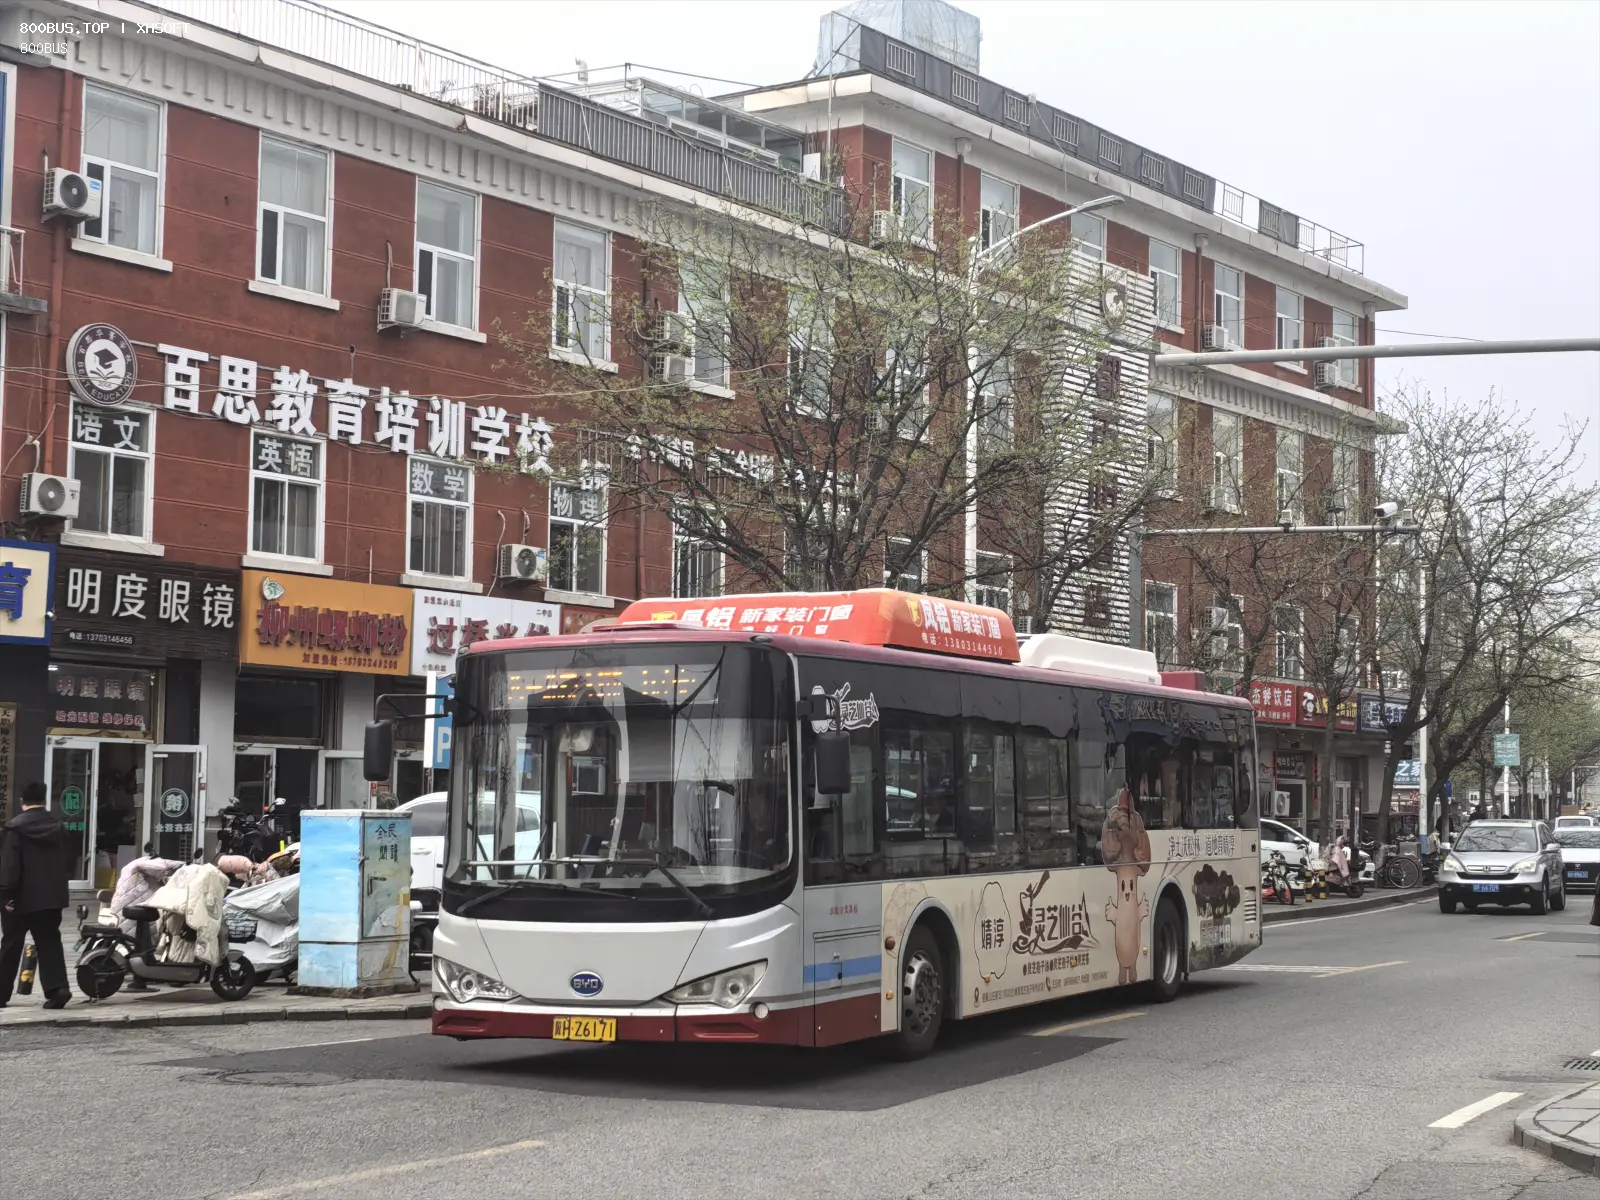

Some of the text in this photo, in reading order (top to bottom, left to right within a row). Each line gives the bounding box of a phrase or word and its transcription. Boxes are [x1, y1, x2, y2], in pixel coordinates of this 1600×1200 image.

[157, 343, 554, 474] 百思教育培训学校
[74, 404, 140, 451] 语文
[258, 437, 314, 478] 英语
[410, 462, 466, 499] 数学
[553, 486, 603, 519] 物理
[66, 567, 236, 629] 明度眼镜
[739, 604, 854, 623] 新家装门窗
[949, 607, 1002, 640] 新家装门窗
[56, 675, 146, 702] 明度眼镜
[573, 978, 599, 988] BYD
